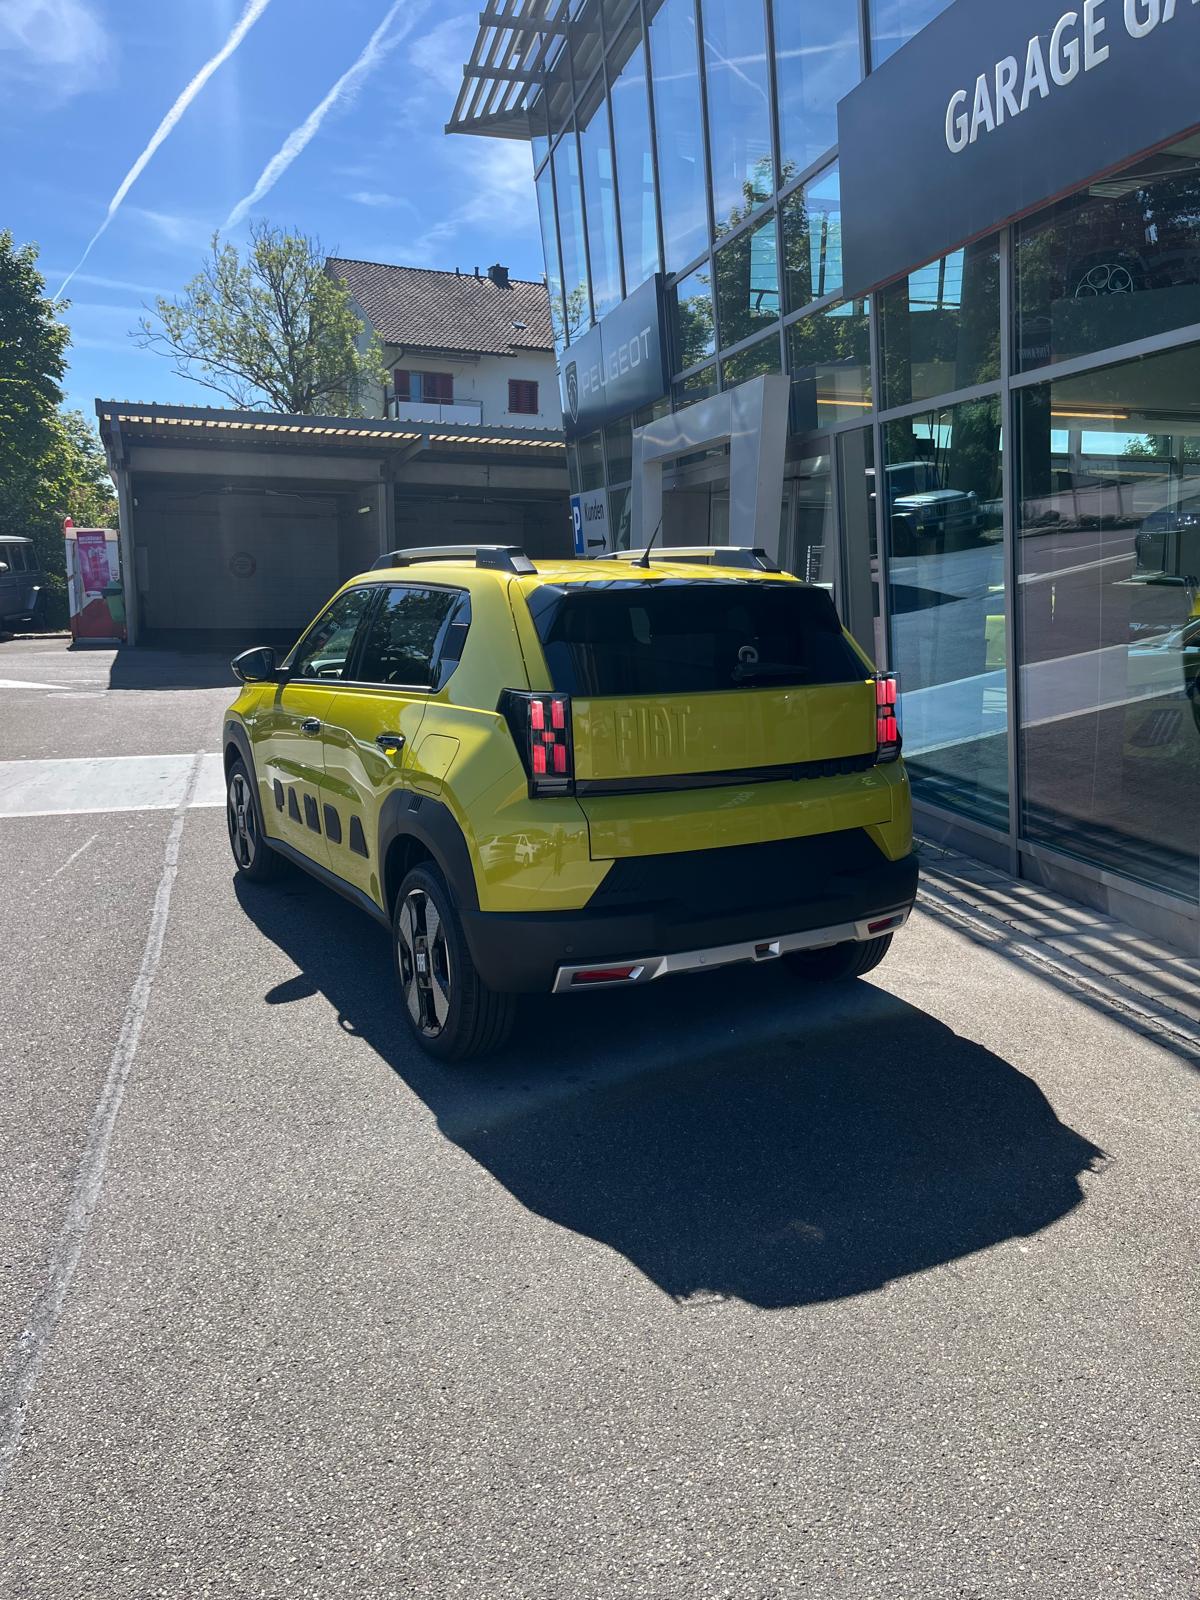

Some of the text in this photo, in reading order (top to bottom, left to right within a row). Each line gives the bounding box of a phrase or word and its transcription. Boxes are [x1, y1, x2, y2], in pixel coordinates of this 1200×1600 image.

[945, 0, 1109, 153] GARAGE
[582, 326, 651, 398] PEUGEOT
[573, 506, 581, 544] P
[584, 499, 604, 521] Kunden
[613, 705, 691, 760] FIAT
[273, 777, 369, 859] PANDA
